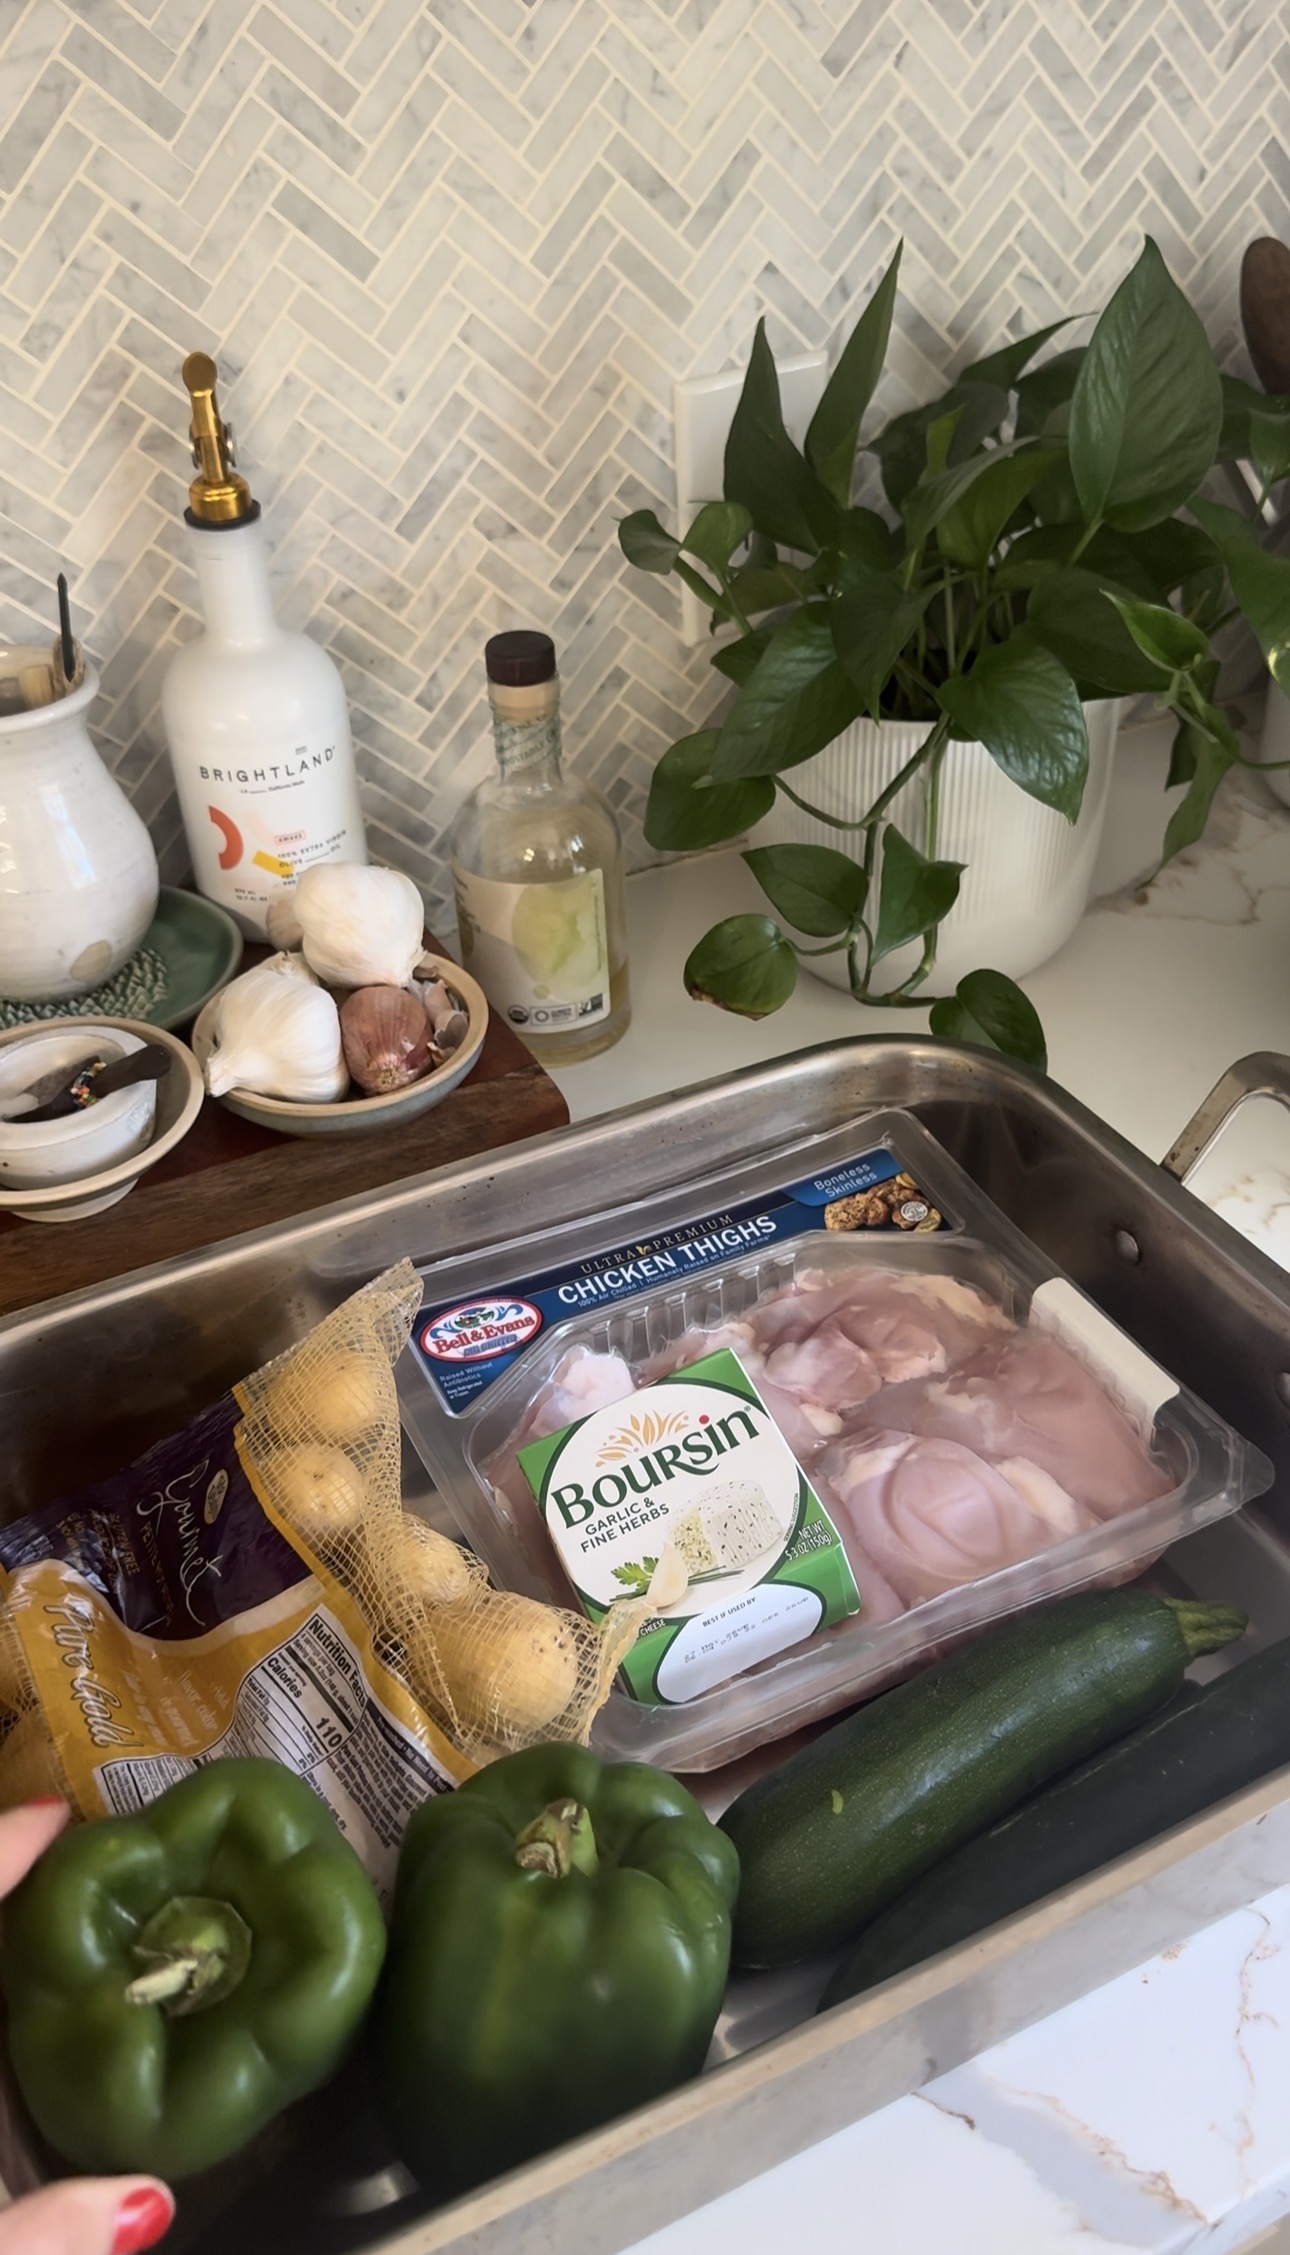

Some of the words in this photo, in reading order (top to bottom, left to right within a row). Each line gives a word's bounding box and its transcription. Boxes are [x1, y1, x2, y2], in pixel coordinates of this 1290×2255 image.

[200, 748, 333, 782] BRIGHTLAND
[301, 843, 323, 854] EXTRA
[814, 1163, 871, 1190] Boneless
[825, 1172, 877, 1198] Skinless
[558, 1252, 677, 1304] CHICKEN
[678, 1215, 778, 1261] THIGHS
[580, 1250, 637, 1275] ULTRA
[652, 1215, 734, 1249] PREMIUM
[577, 1295, 598, 1307] 100%
[598, 1291, 609, 1302] Air
[610, 1282, 637, 1296] Chilled
[646, 1267, 683, 1285] Humanely
[683, 1256, 710, 1270] Raised
[709, 1252, 720, 1261] on
[720, 1242, 745, 1258] Family
[440, 1371, 465, 1382] Raised
[465, 1362, 494, 1374] Without
[443, 1373, 482, 1388] Antibiotics
[580, 1528, 617, 1553] FINE
[620, 1503, 670, 1535] HERBS
[585, 1502, 642, 1536] GARLIC
[643, 1497, 655, 1508] &
[798, 1525, 814, 1541] NET
[812, 1519, 823, 1535] WT
[137, 1458, 223, 1626] Gourmet
[785, 1546, 799, 1561] 5.3
[798, 1541, 809, 1555] OZ
[807, 1530, 832, 1551] (150g)
[124, 1551, 140, 1576] FREE
[640, 1618, 666, 1637] CHEESE
[702, 1615, 720, 1628] BEST
[720, 1611, 727, 1621] IF
[727, 1602, 747, 1618] USED
[748, 1596, 757, 1607] BY
[308, 1618, 353, 1672] Nutrition
[43, 1600, 95, 1669] Pure
[70, 1677, 144, 1747] Gold
[267, 1657, 303, 1699] Calories
[315, 1717, 344, 1748] 110
[405, 1747, 416, 1759] No
[412, 1755, 429, 1773] Need
